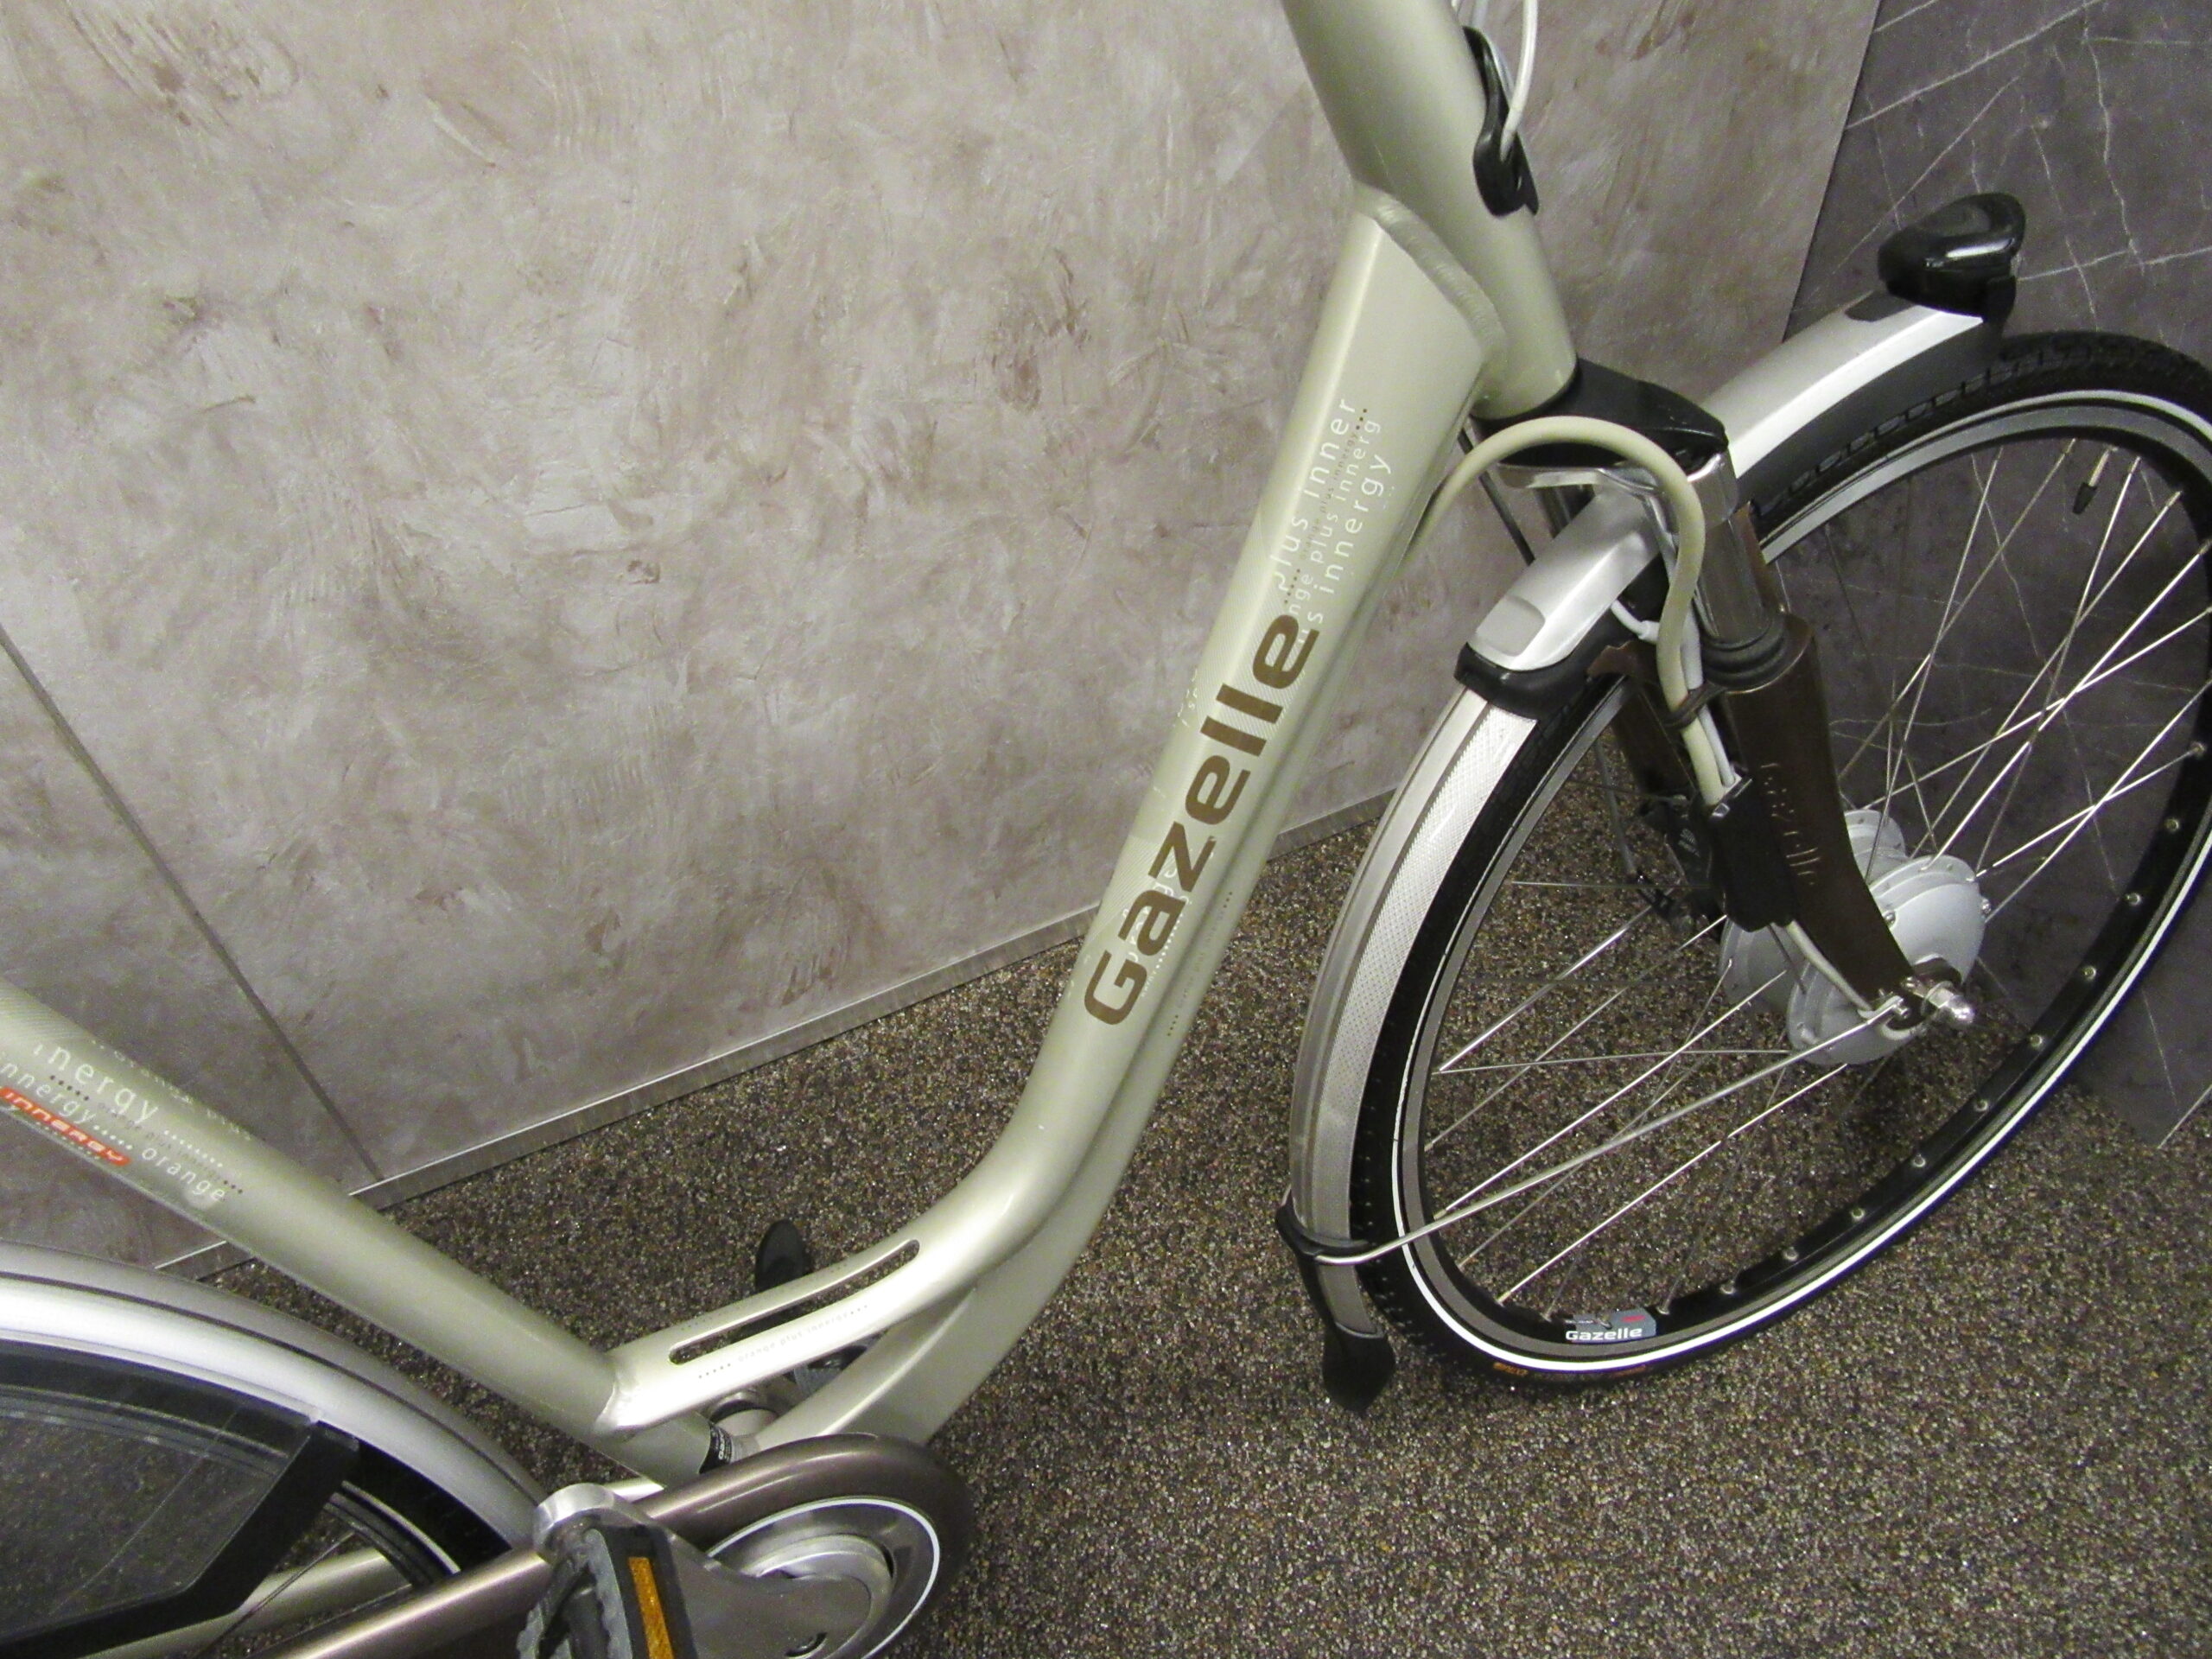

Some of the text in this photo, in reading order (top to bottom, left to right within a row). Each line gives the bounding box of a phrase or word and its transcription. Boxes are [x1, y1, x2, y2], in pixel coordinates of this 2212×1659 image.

[1310, 512, 1338, 564] plus
[1331, 420, 1382, 502] innerg
[1313, 454, 1392, 595] innergy
[1084, 613, 1320, 1027] Gazelle
[141, 1147, 226, 1201] orange
[1565, 1326, 1643, 1341] Gazelle
